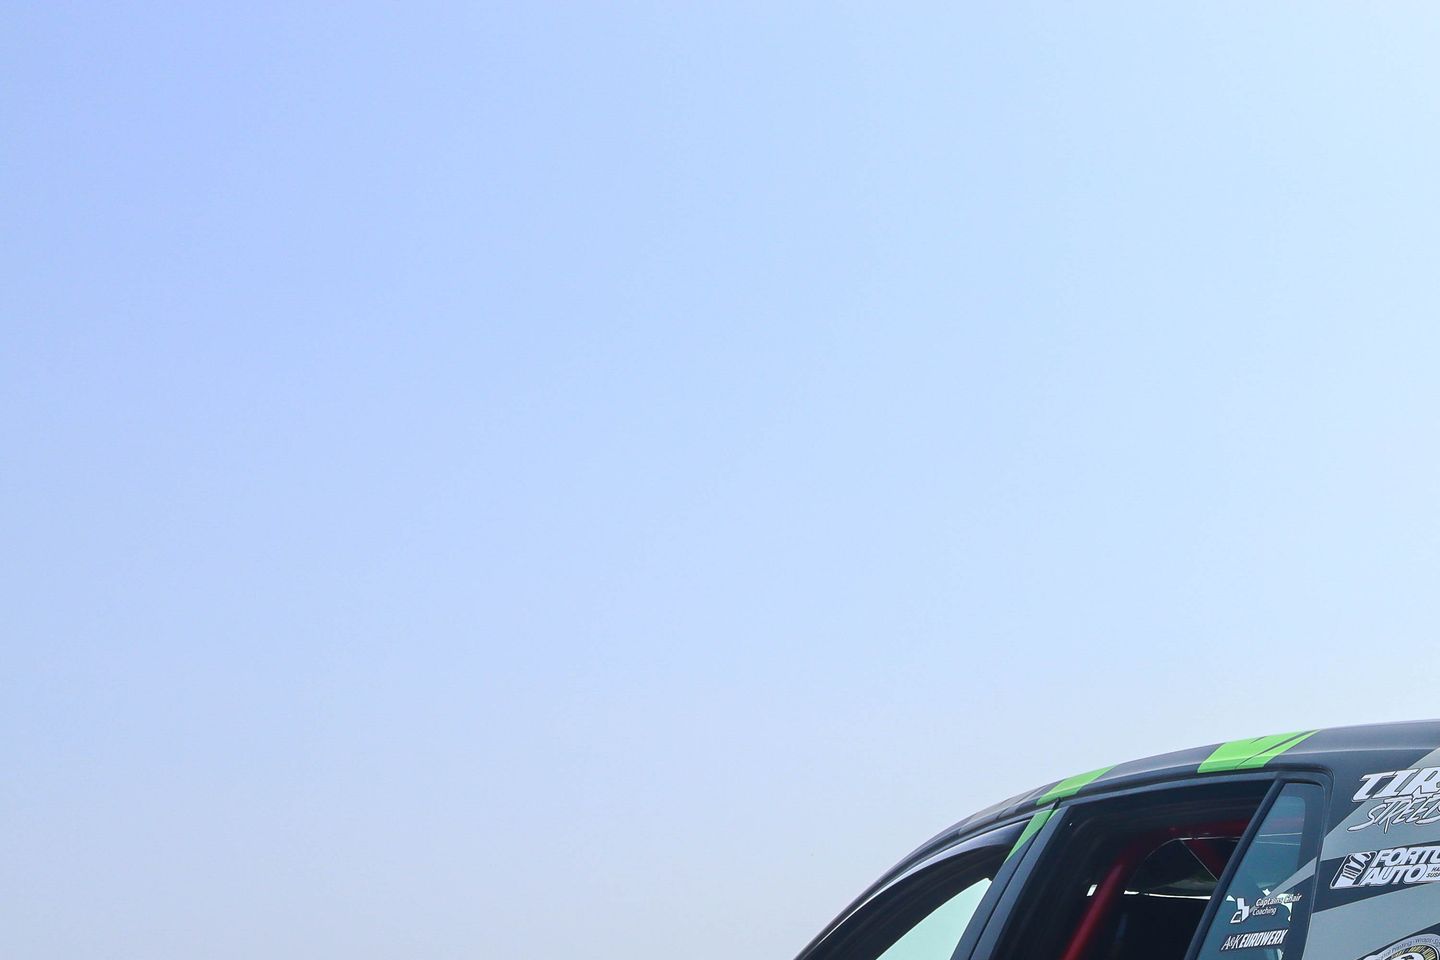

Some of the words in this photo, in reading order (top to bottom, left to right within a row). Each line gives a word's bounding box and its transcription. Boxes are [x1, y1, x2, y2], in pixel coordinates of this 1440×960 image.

[1359, 864, 1428, 887] AUTO
[1252, 906, 1277, 916] Coaching
[1239, 929, 1288, 949] EUROWERX
